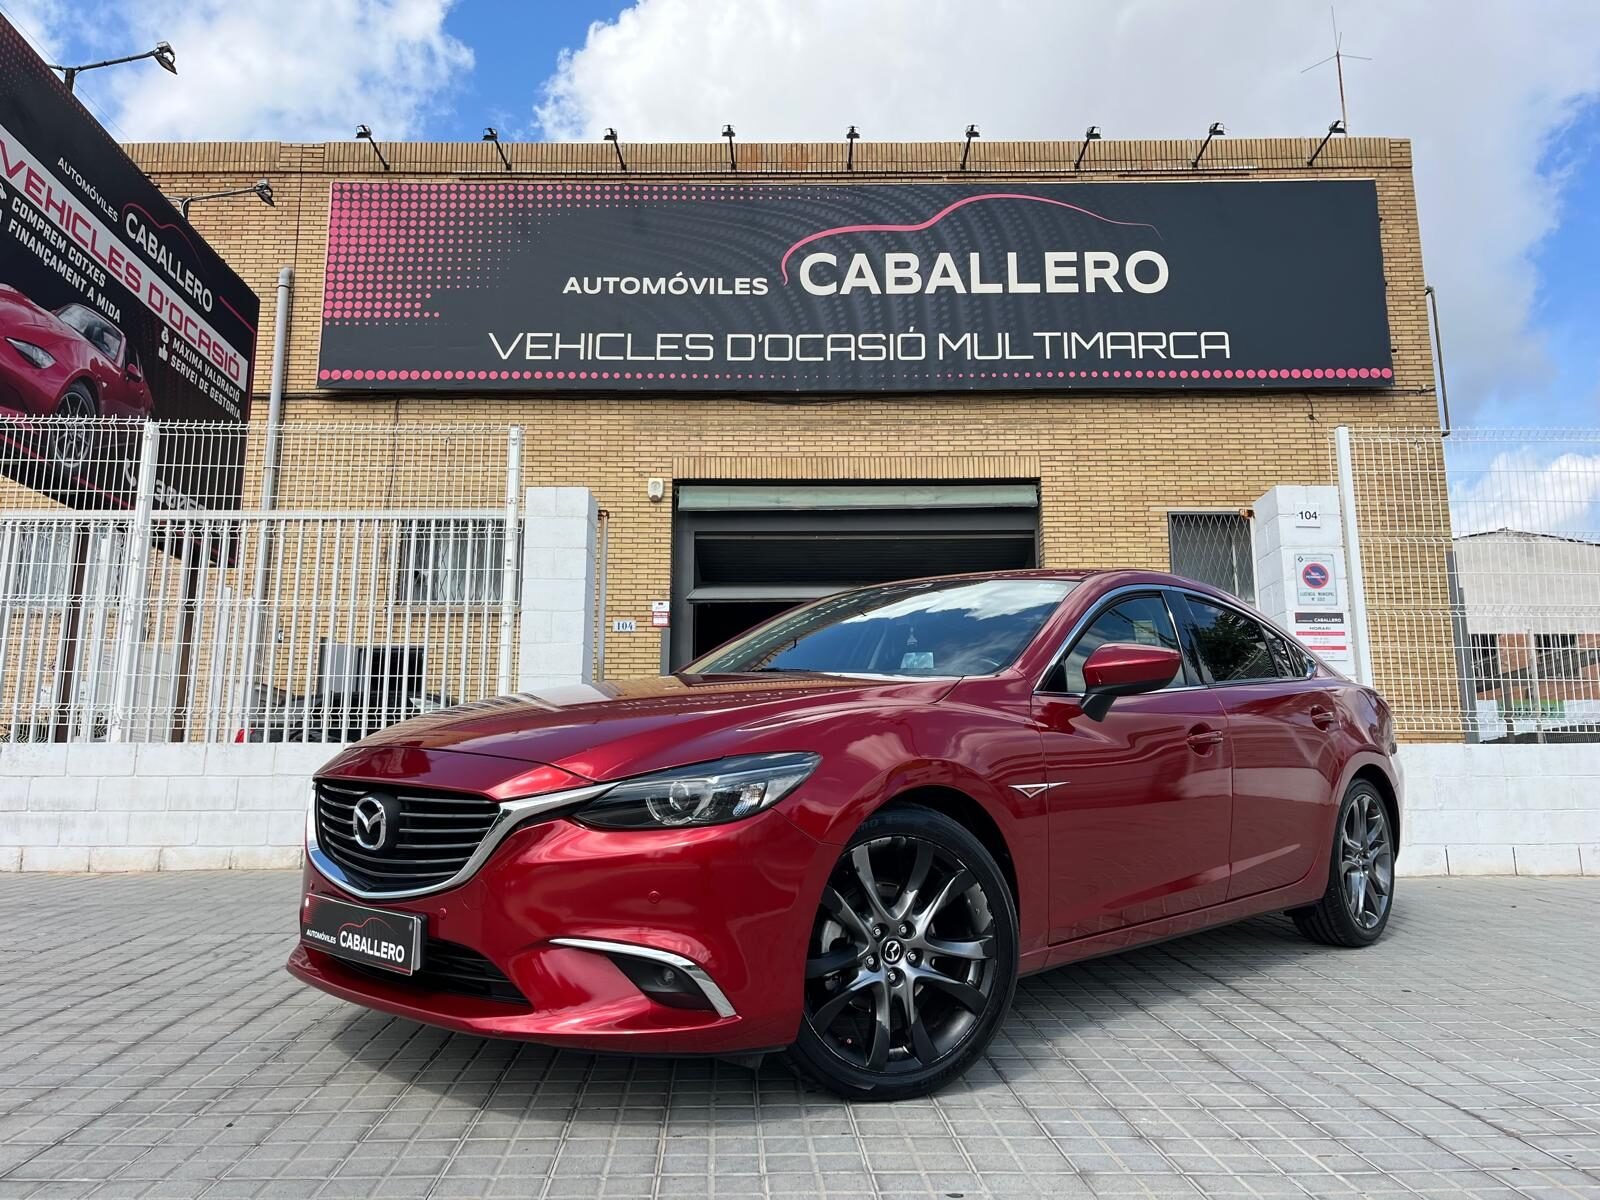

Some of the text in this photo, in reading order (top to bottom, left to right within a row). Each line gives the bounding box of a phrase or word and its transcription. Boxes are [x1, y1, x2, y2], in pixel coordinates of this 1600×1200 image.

[11, 196, 107, 288] COMPREM COTXES
[57, 156, 214, 313] AUTOMÓVILES CABALLERO
[0, 139, 240, 382] VEHICLES D'OCASIÓ
[8, 218, 122, 324] FINANÇAMENT A MIDA
[562, 250, 1170, 297] AUTOMÓVILES CABALLERO
[488, 325, 1232, 362] VEHICLES D'OCASIÓ MULTIMARCA
[170, 354, 241, 420] SERVEI DE GESTORIA
[204, 363, 241, 403] VALORACIÓ
[1298, 511, 1318, 521] 104
[617, 621, 633, 631] 104
[306, 928, 405, 963] AUTOMÓVILES CABALLERO
